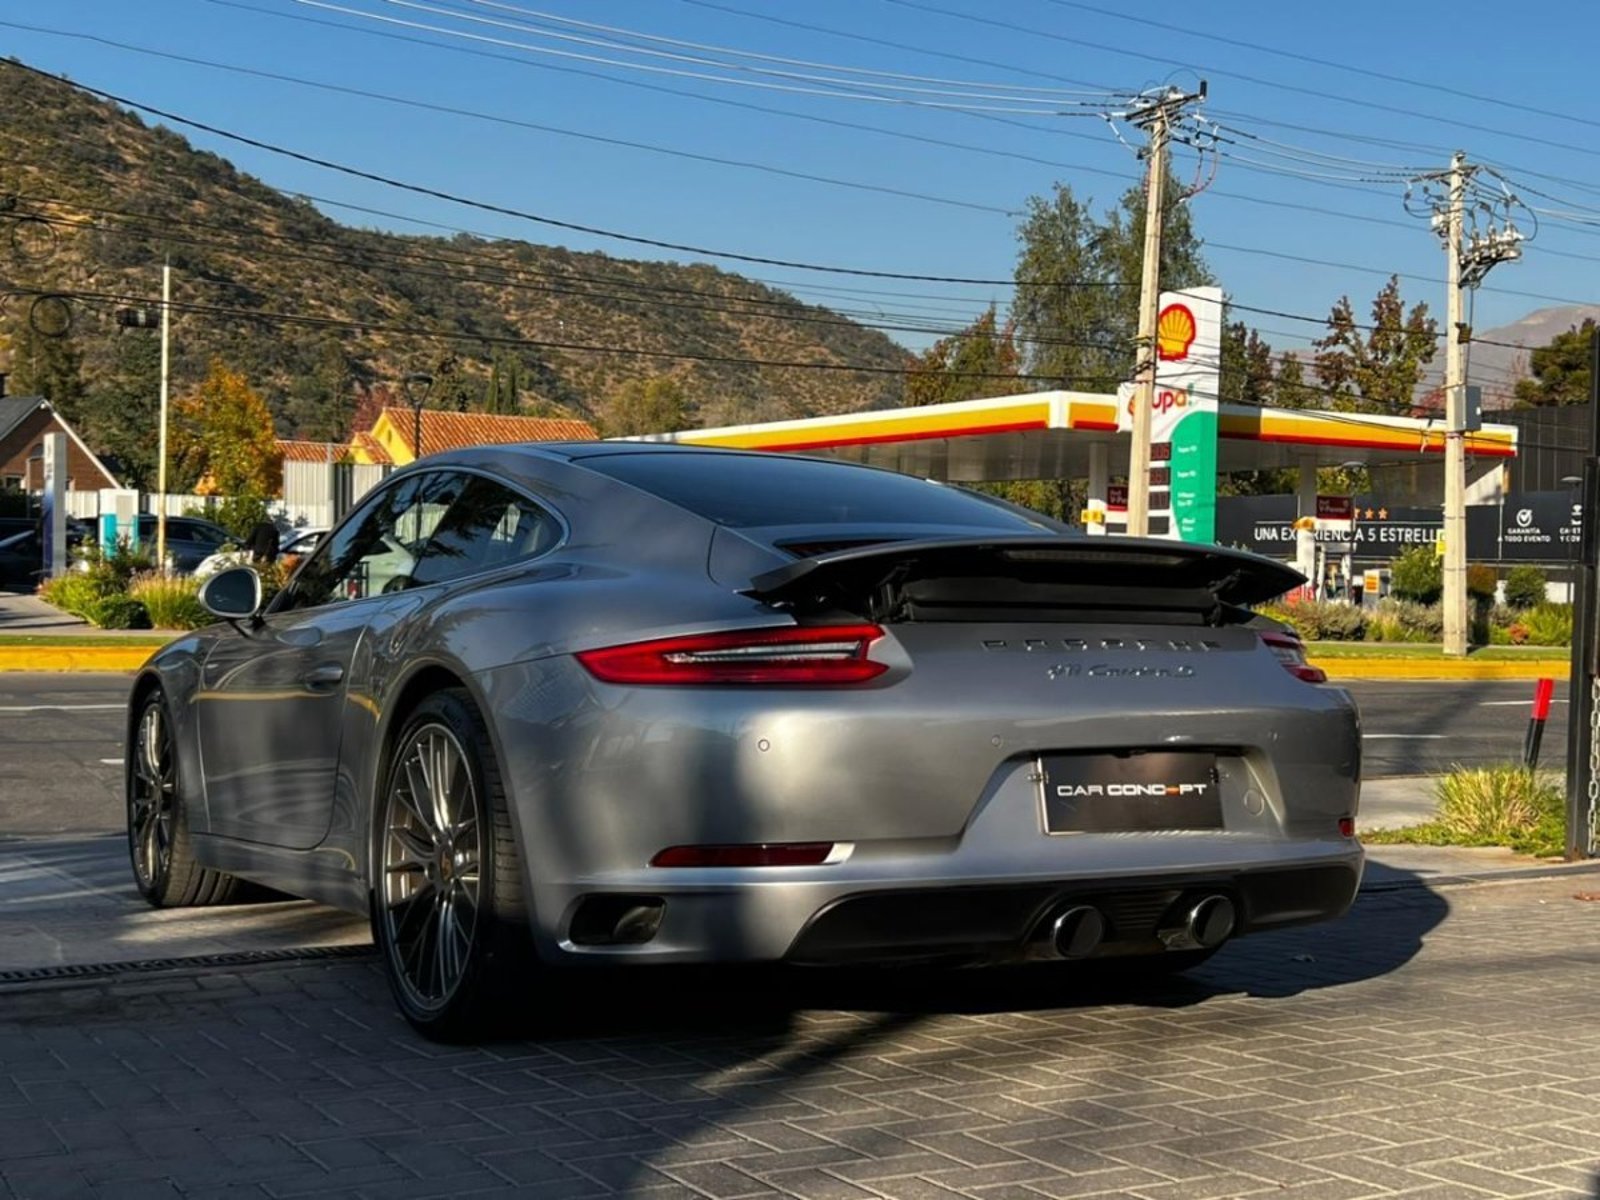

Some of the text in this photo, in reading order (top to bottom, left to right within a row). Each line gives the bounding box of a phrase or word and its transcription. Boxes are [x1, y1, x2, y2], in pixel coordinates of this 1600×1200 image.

[1254, 527, 1438, 543] UNA EXRIENCA 5 ESTRELL
[1504, 535, 1522, 543] TODO
[1523, 535, 1552, 543] EVENTO
[1056, 784, 1104, 797] CAR
